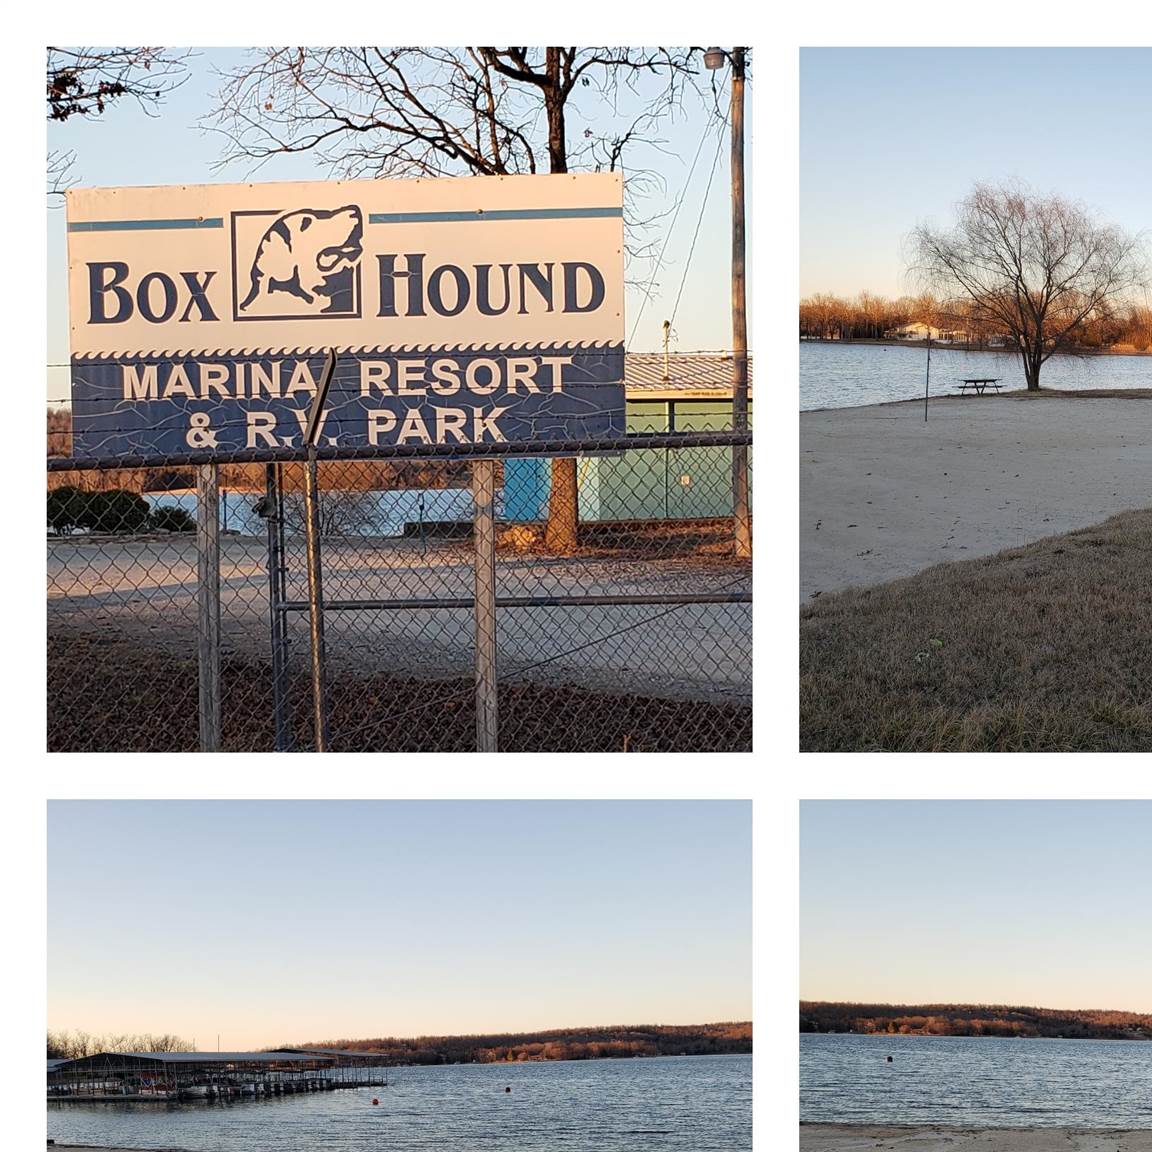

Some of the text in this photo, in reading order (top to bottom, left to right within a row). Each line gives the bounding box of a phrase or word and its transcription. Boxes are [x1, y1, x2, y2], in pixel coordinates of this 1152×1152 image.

[123, 356, 573, 401] MARINA RESORT
[185, 411, 219, 450] &
[368, 407, 510, 446] PARK
